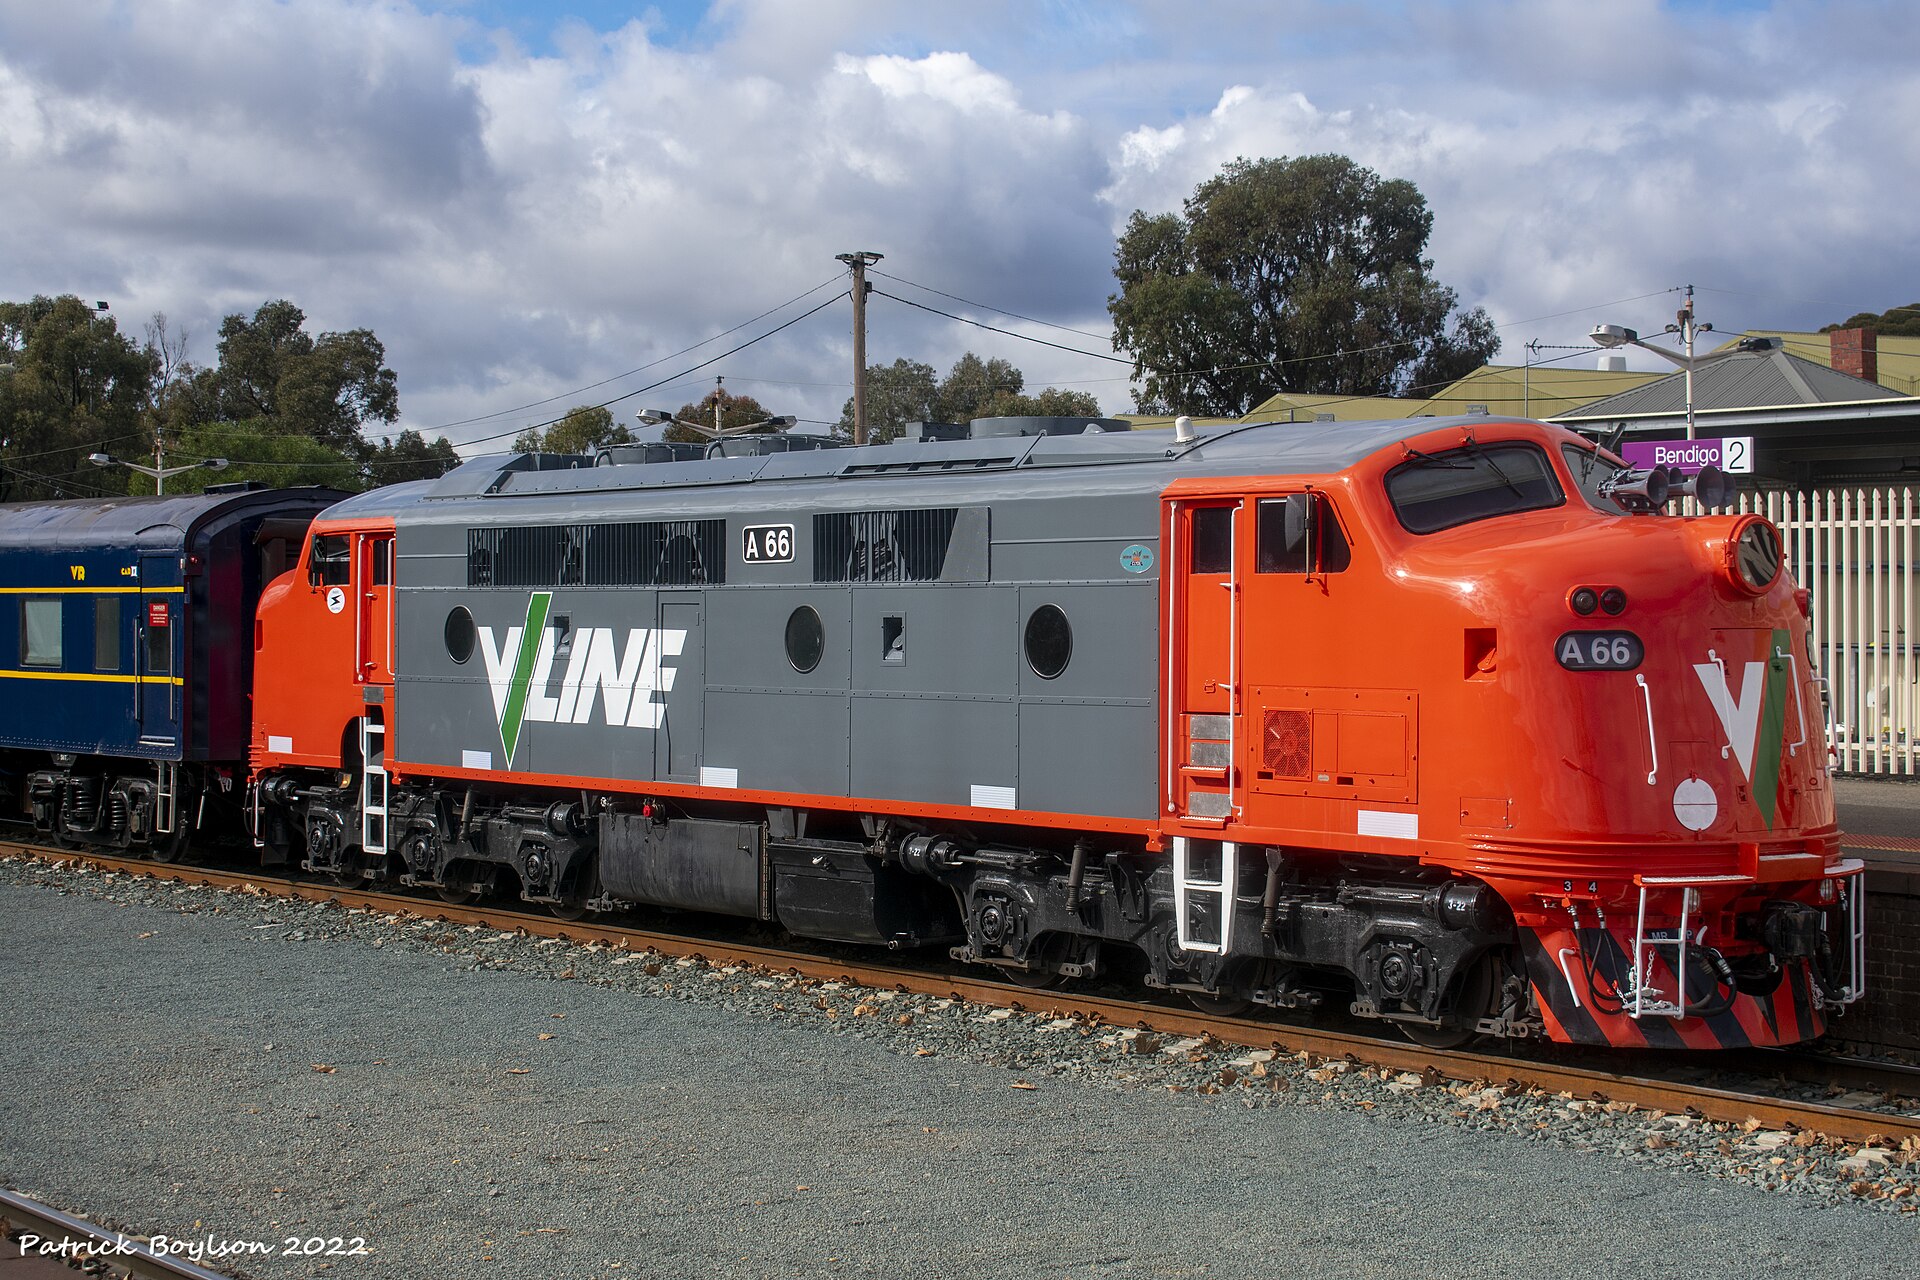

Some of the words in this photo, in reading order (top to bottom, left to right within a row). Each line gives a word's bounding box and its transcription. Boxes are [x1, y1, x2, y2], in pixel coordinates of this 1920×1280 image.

[1655, 445, 1719, 467] Bendigo
[1729, 441, 1745, 470] 2
[746, 531, 759, 559] A
[765, 530, 790, 558] 66
[70, 565, 86, 581] VR
[1561, 636, 1585, 664] A
[1591, 637, 1630, 664] 66
[1564, 880, 1571, 892] 3
[1588, 881, 1597, 893] 4
[1447, 898, 1466, 911] 3-22
[1651, 931, 1668, 940] MR
